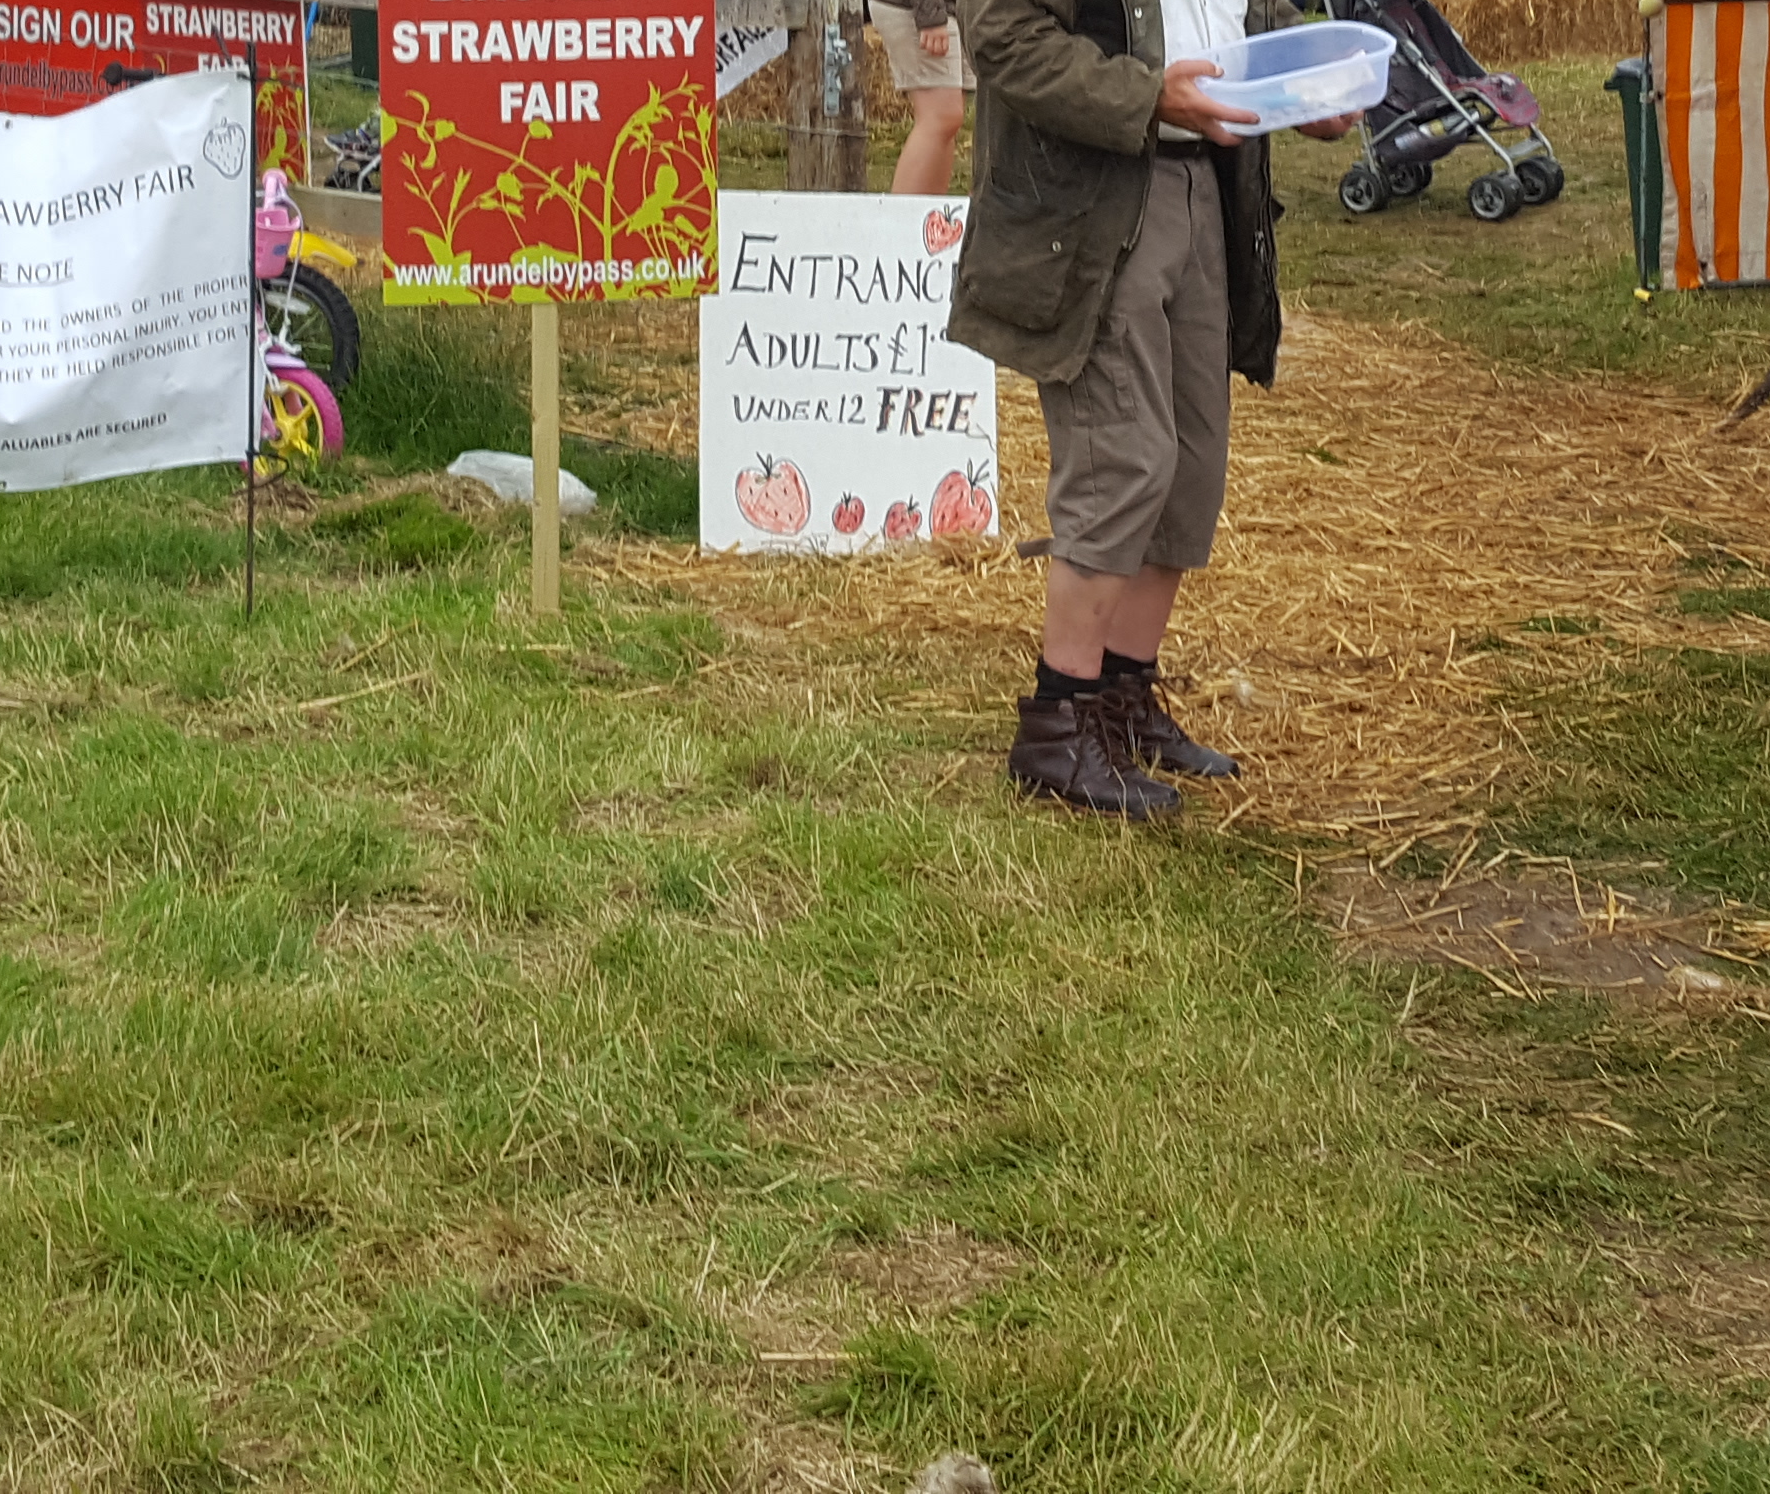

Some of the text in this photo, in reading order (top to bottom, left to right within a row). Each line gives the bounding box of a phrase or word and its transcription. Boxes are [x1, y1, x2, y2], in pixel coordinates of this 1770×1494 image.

[70, 9, 135, 53] OUR
[146, 2, 296, 46] STRAWBERRY
[391, 16, 705, 63] STRAWBERRY
[500, 80, 600, 123] FAIR
[134, 164, 195, 201] FAIR
[17, 258, 74, 285] NOTE
[394, 250, 706, 291] www.arundelbypass.co.uk
[9, 342, 50, 359] YOUR
[57, 328, 129, 354] PERSONAL
[188, 305, 217, 325] YOU
[23, 318, 50, 333] THE
[61, 302, 121, 329] OWNERS
[132, 297, 150, 314] OF
[160, 287, 184, 307] THE
[42, 366, 57, 379] BE
[67, 360, 105, 378] HELD
[112, 334, 202, 369] RESPONSIBLE
[207, 326, 236, 345] FOR
[725, 320, 880, 373] ADULTS
[76, 425, 101, 442] ARE
[106, 412, 167, 436] SECURED
[732, 385, 978, 438] UNDER 12 FREE
